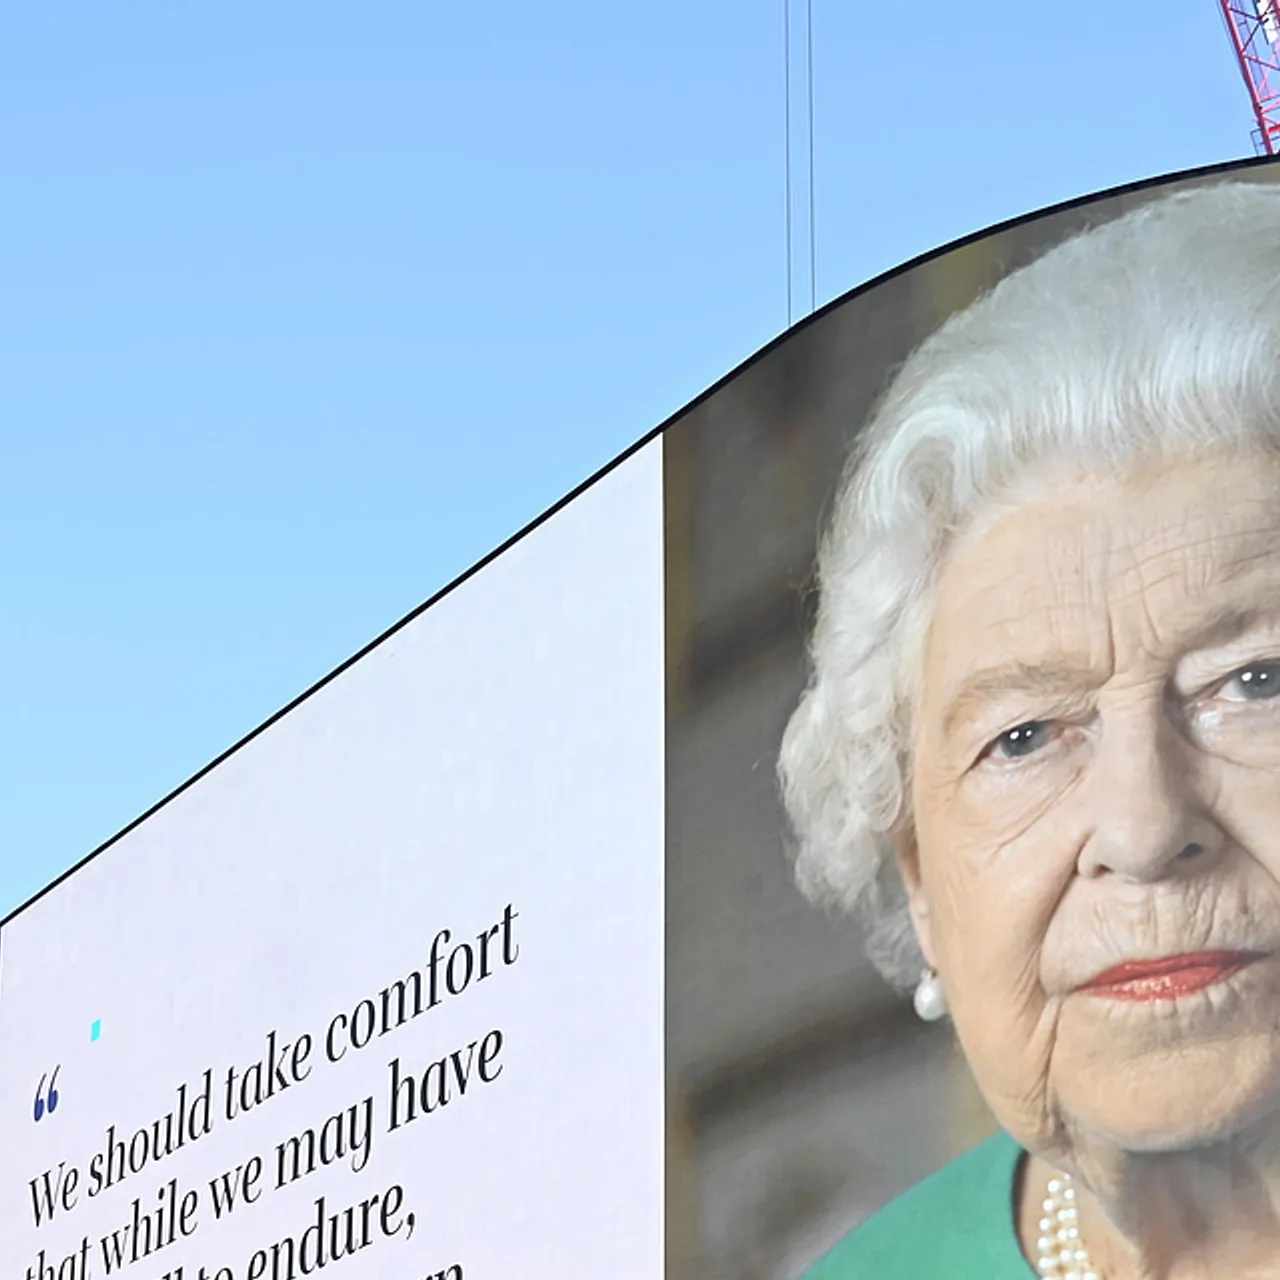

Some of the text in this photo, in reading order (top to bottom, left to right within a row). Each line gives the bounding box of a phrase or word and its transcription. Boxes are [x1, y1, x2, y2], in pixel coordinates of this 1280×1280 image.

[28, 903, 519, 1228] We should take comfort
[99, 1177, 198, 1276] while
[208, 1156, 262, 1220] we
[274, 1096, 374, 1190] may
[387, 1029, 503, 1133] have
